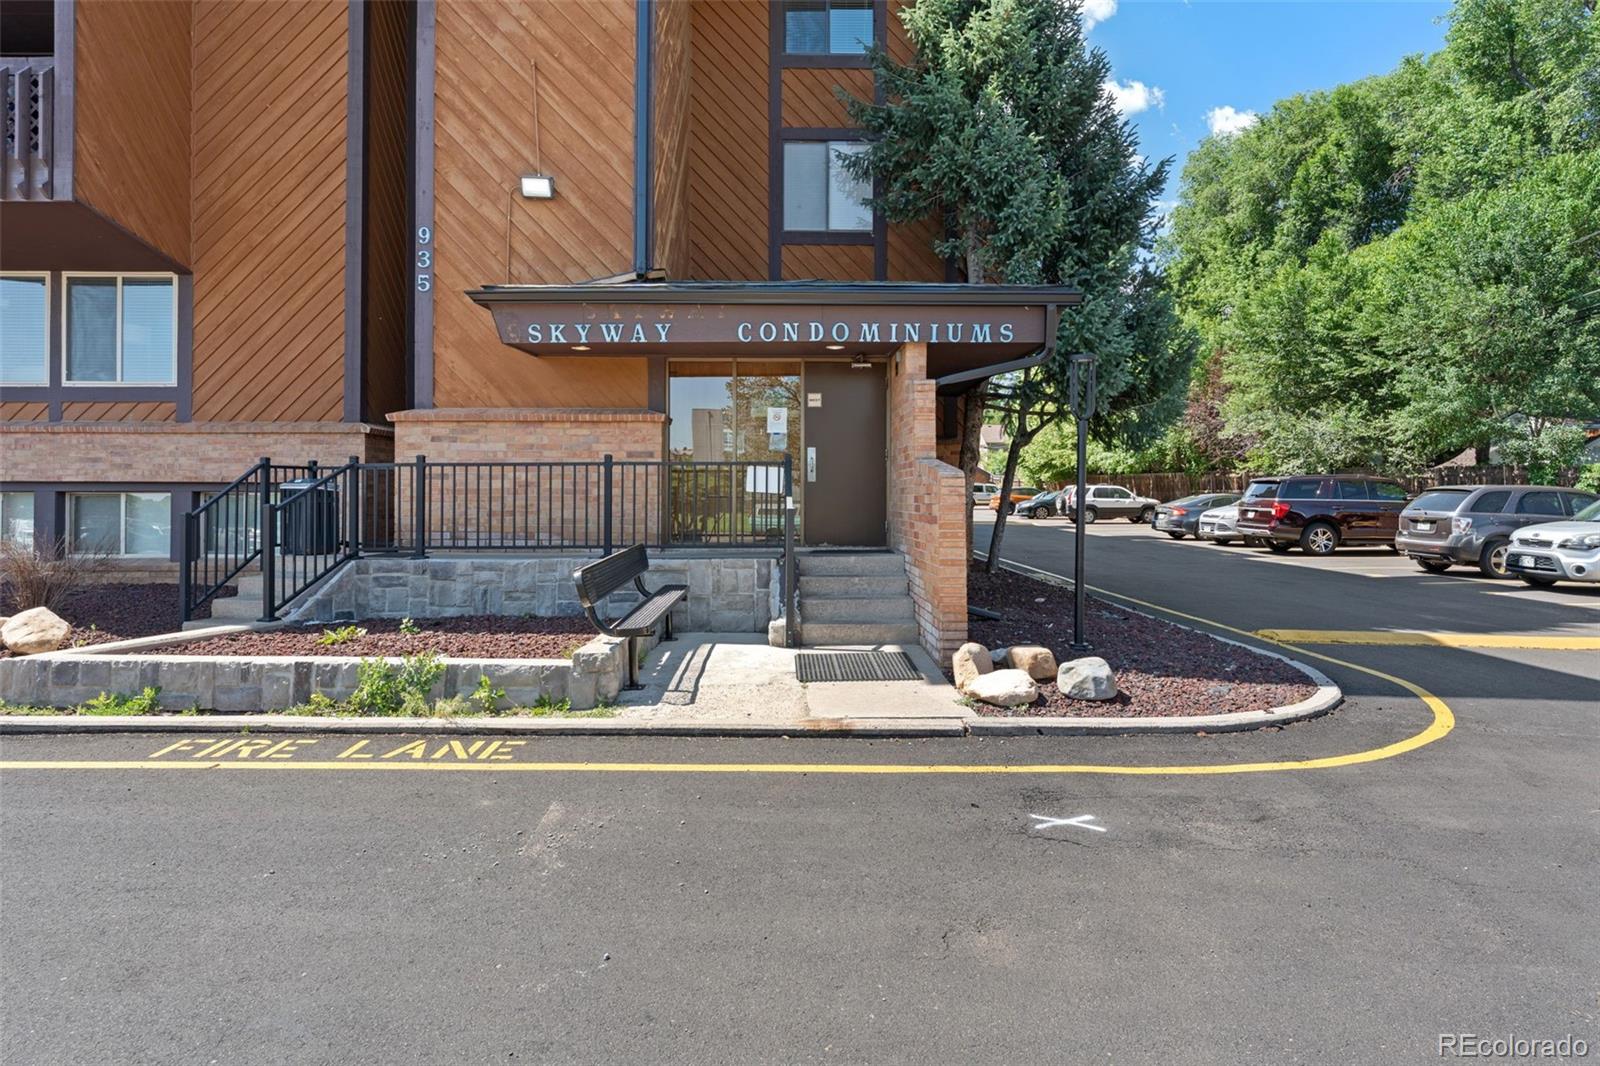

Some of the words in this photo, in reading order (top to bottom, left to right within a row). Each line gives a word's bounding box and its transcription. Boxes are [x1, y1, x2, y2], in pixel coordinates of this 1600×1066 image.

[417, 226, 431, 292] 935
[527, 322, 672, 344] SKYWAY
[736, 321, 1014, 344] CONDOMINIUMS
[148, 738, 319, 759] FIRE
[336, 738, 527, 760] LANE
